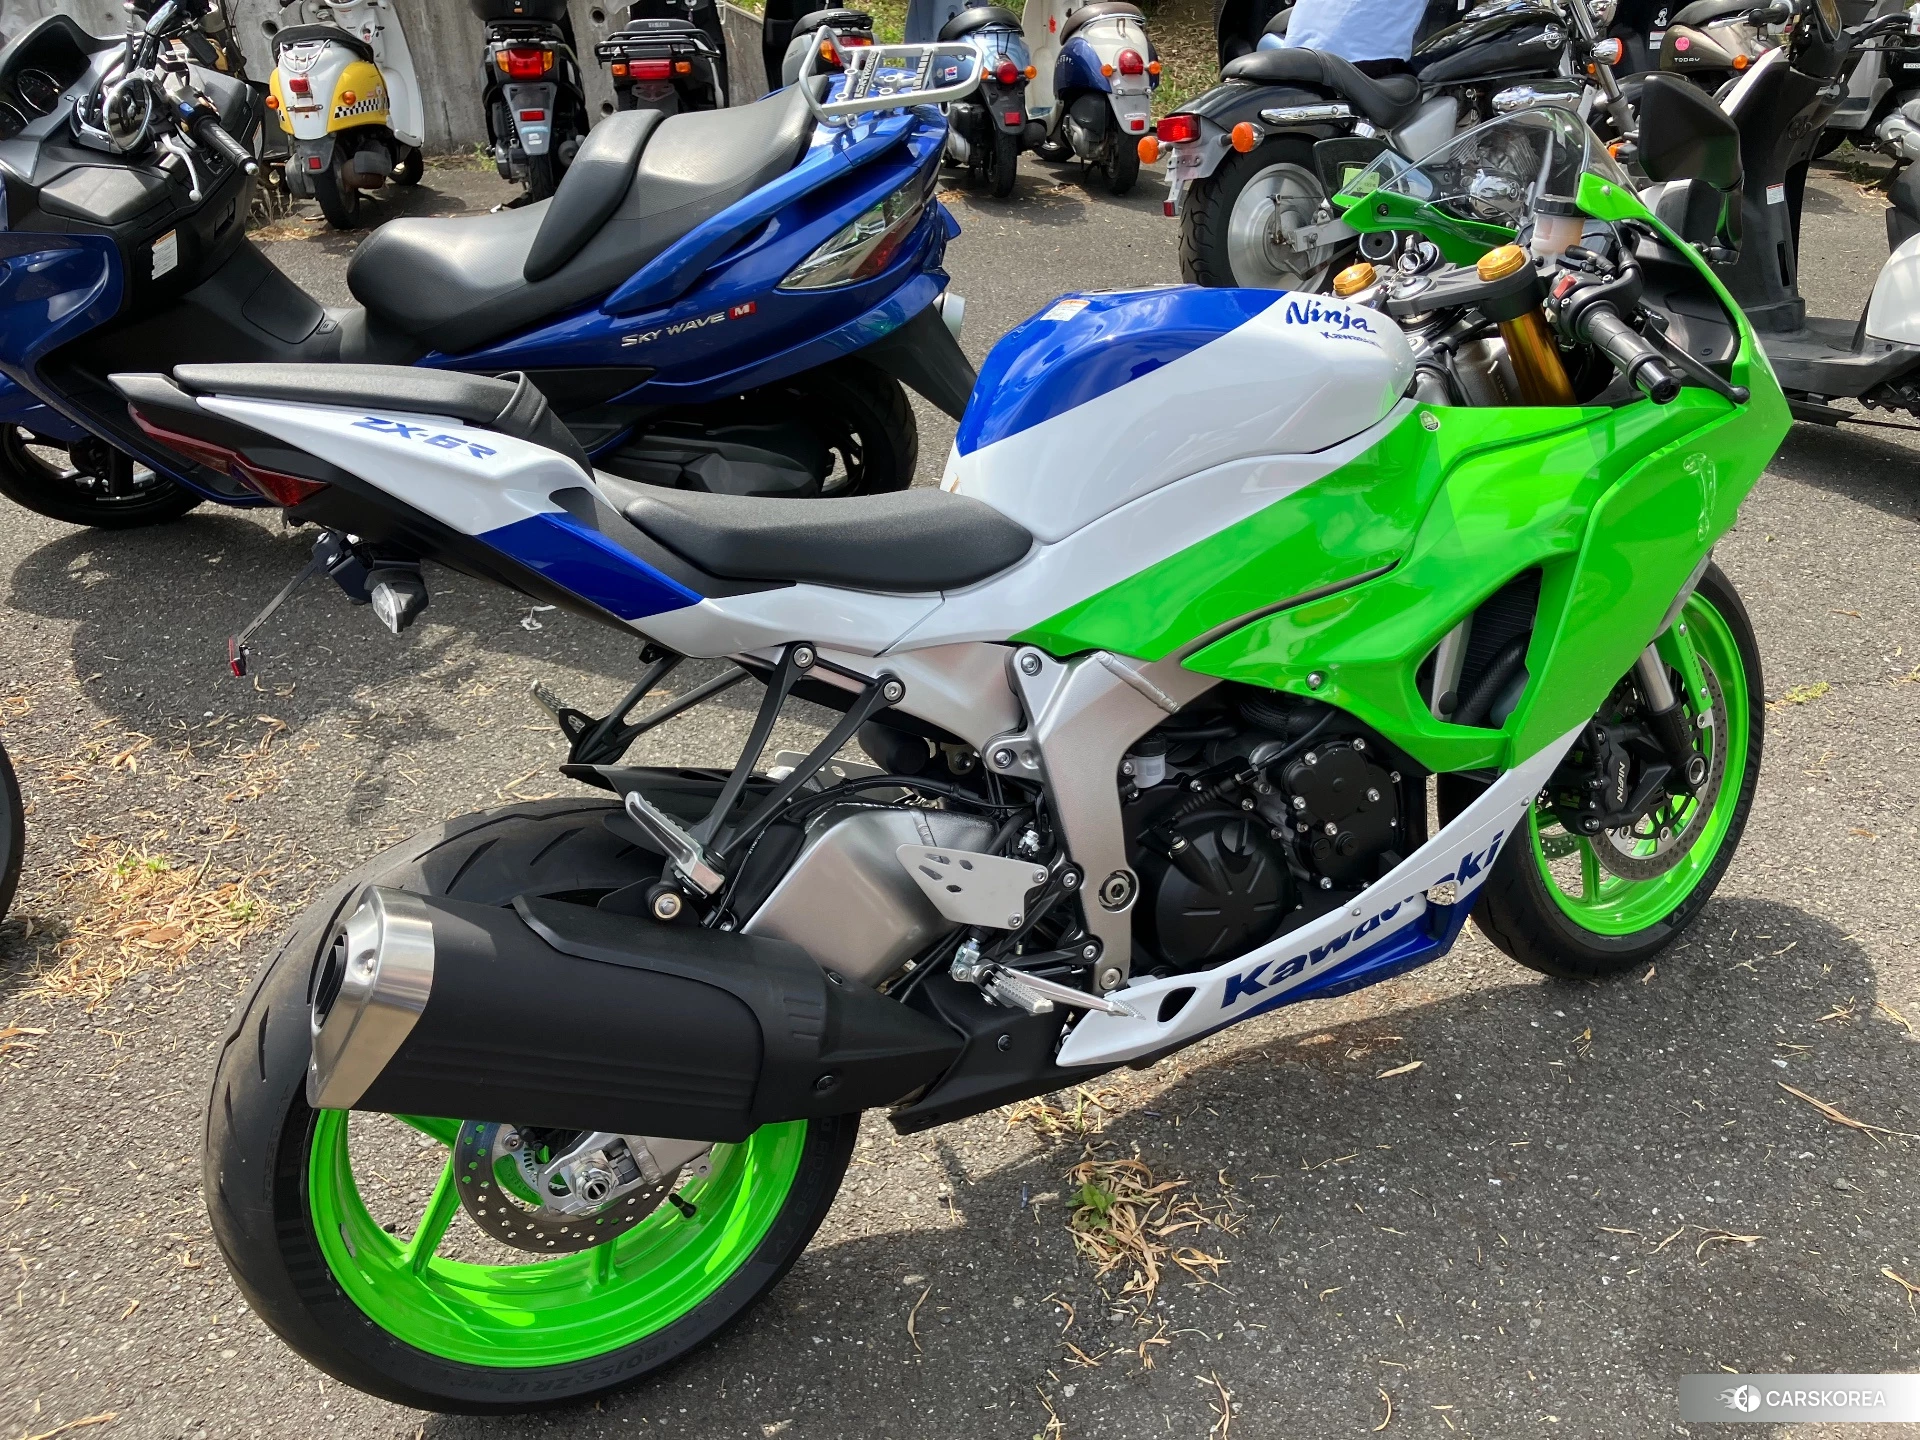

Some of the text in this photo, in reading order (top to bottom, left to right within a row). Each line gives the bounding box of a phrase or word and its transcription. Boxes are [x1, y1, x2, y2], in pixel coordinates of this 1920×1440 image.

[621, 304, 750, 347] SKY WAVE M
[1285, 299, 1377, 334] Ninja
[350, 416, 498, 460] ZX-6R
